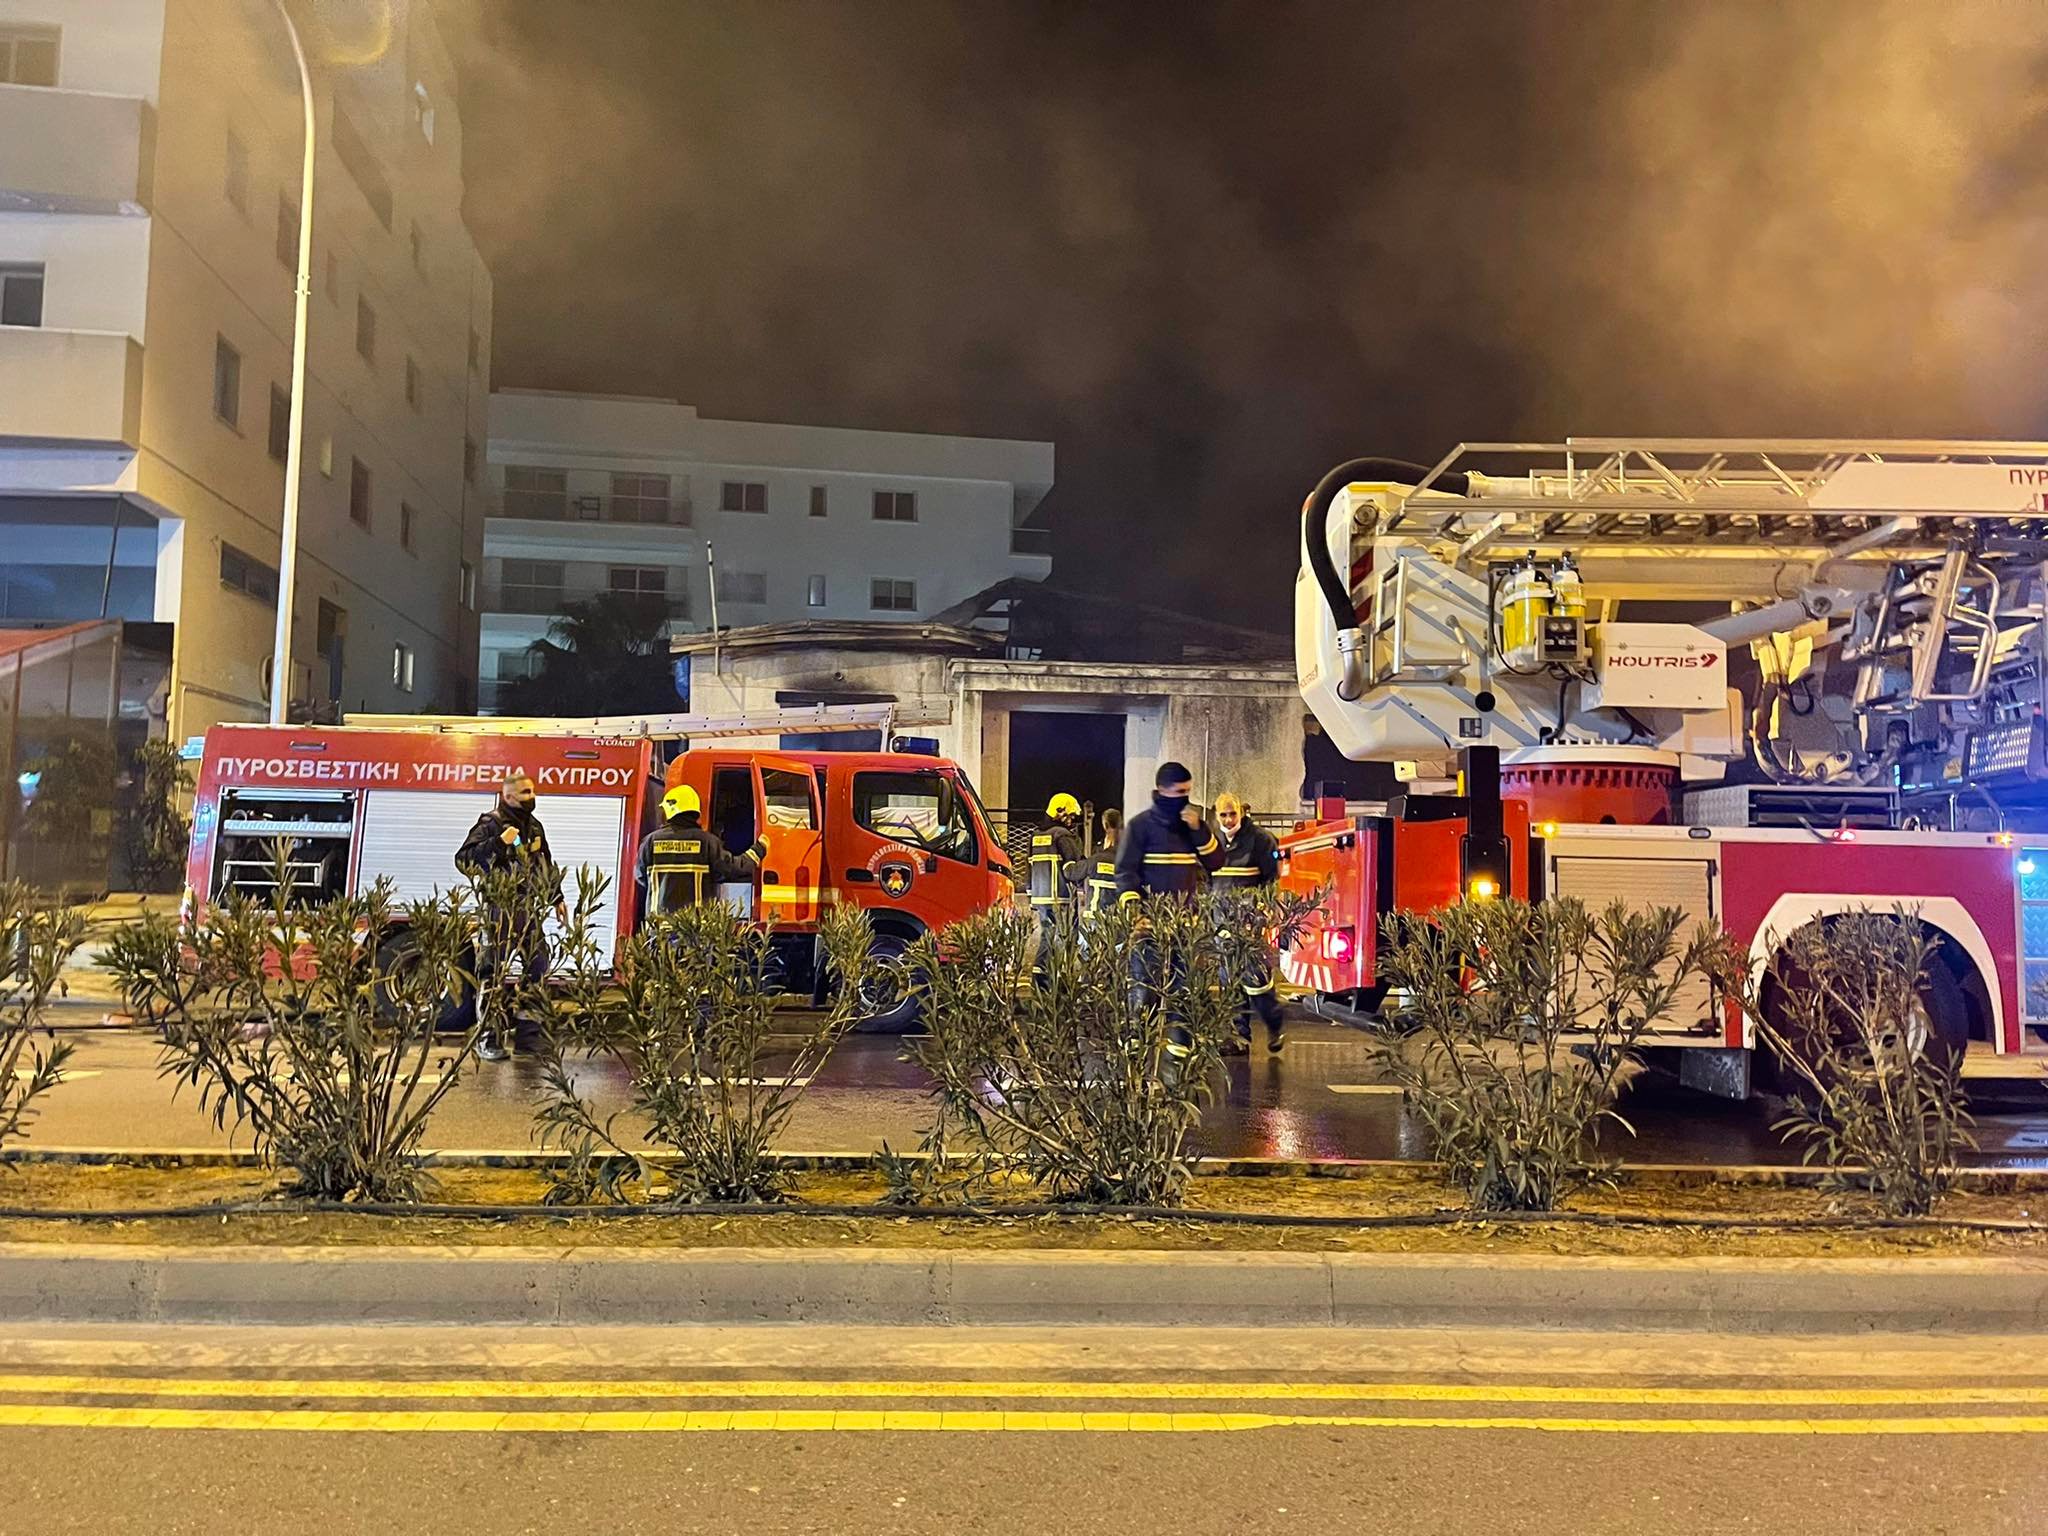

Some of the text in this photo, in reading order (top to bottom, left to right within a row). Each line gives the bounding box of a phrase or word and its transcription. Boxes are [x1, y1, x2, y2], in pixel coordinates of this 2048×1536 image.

[1608, 656, 1698, 668] HOUTRIS
[217, 757, 400, 781] ΠΥΡΟΣΒΕΣΤΙΚΗ
[538, 767, 634, 786] ΚΥΠΡΟΥ
